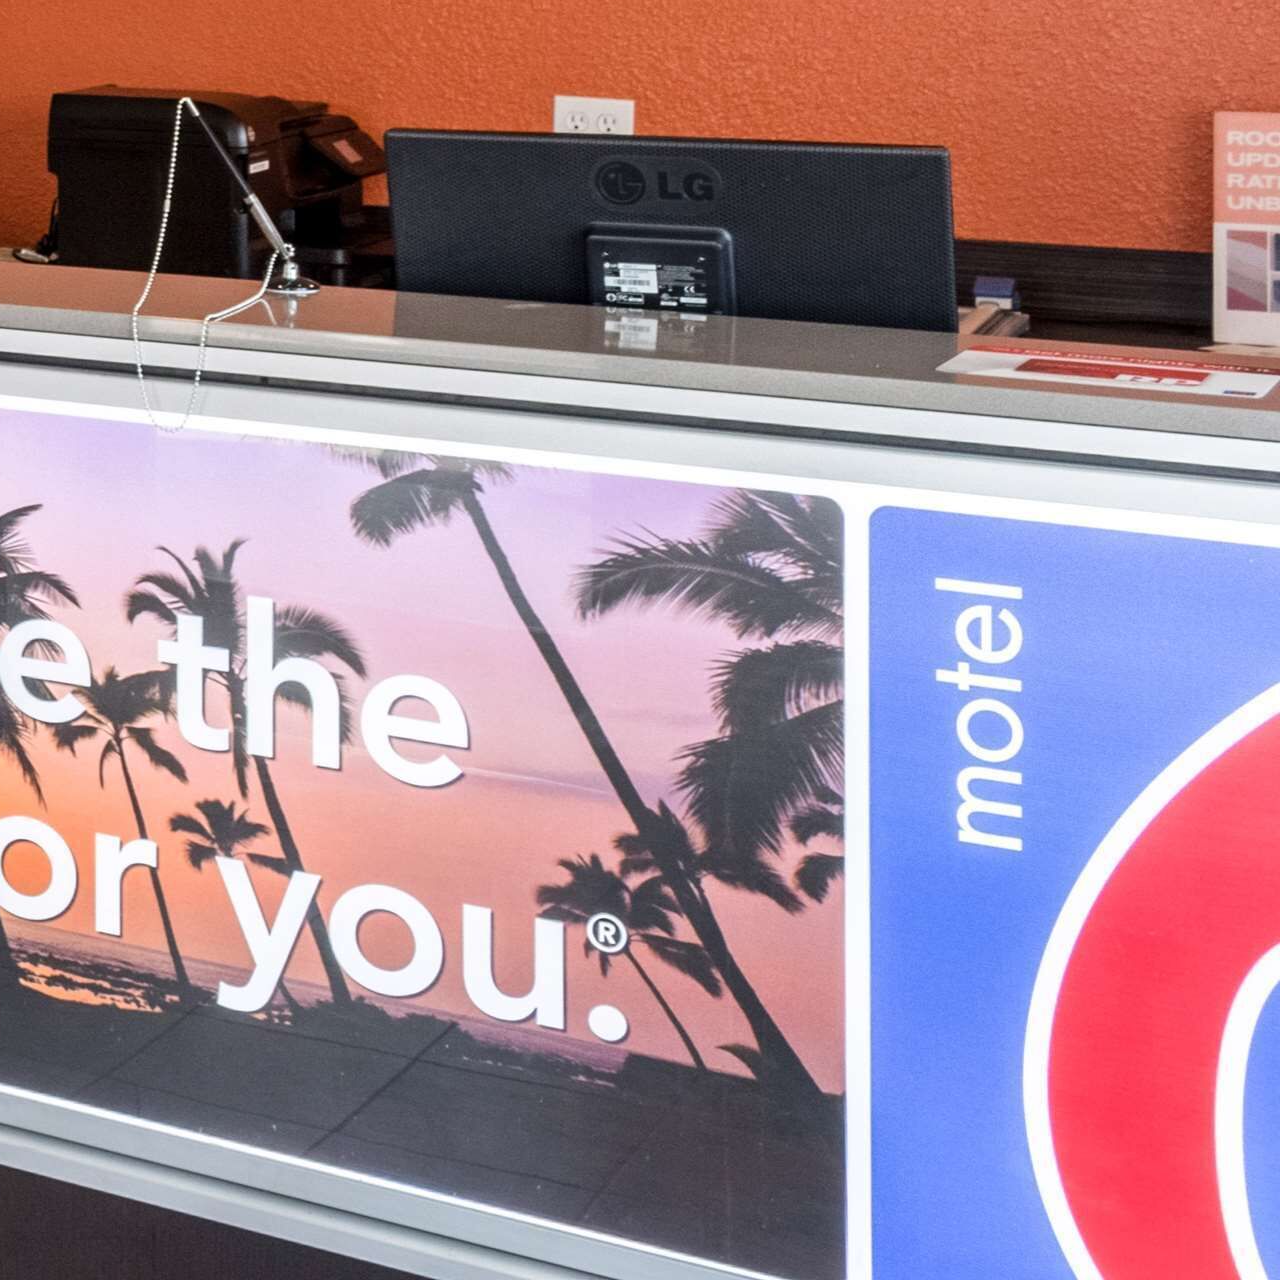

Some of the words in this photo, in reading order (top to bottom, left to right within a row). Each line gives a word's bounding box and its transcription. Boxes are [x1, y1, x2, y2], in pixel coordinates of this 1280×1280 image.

[656, 170, 716, 201] LG
[157, 595, 470, 789] the
[934, 576, 1024, 853] motel
